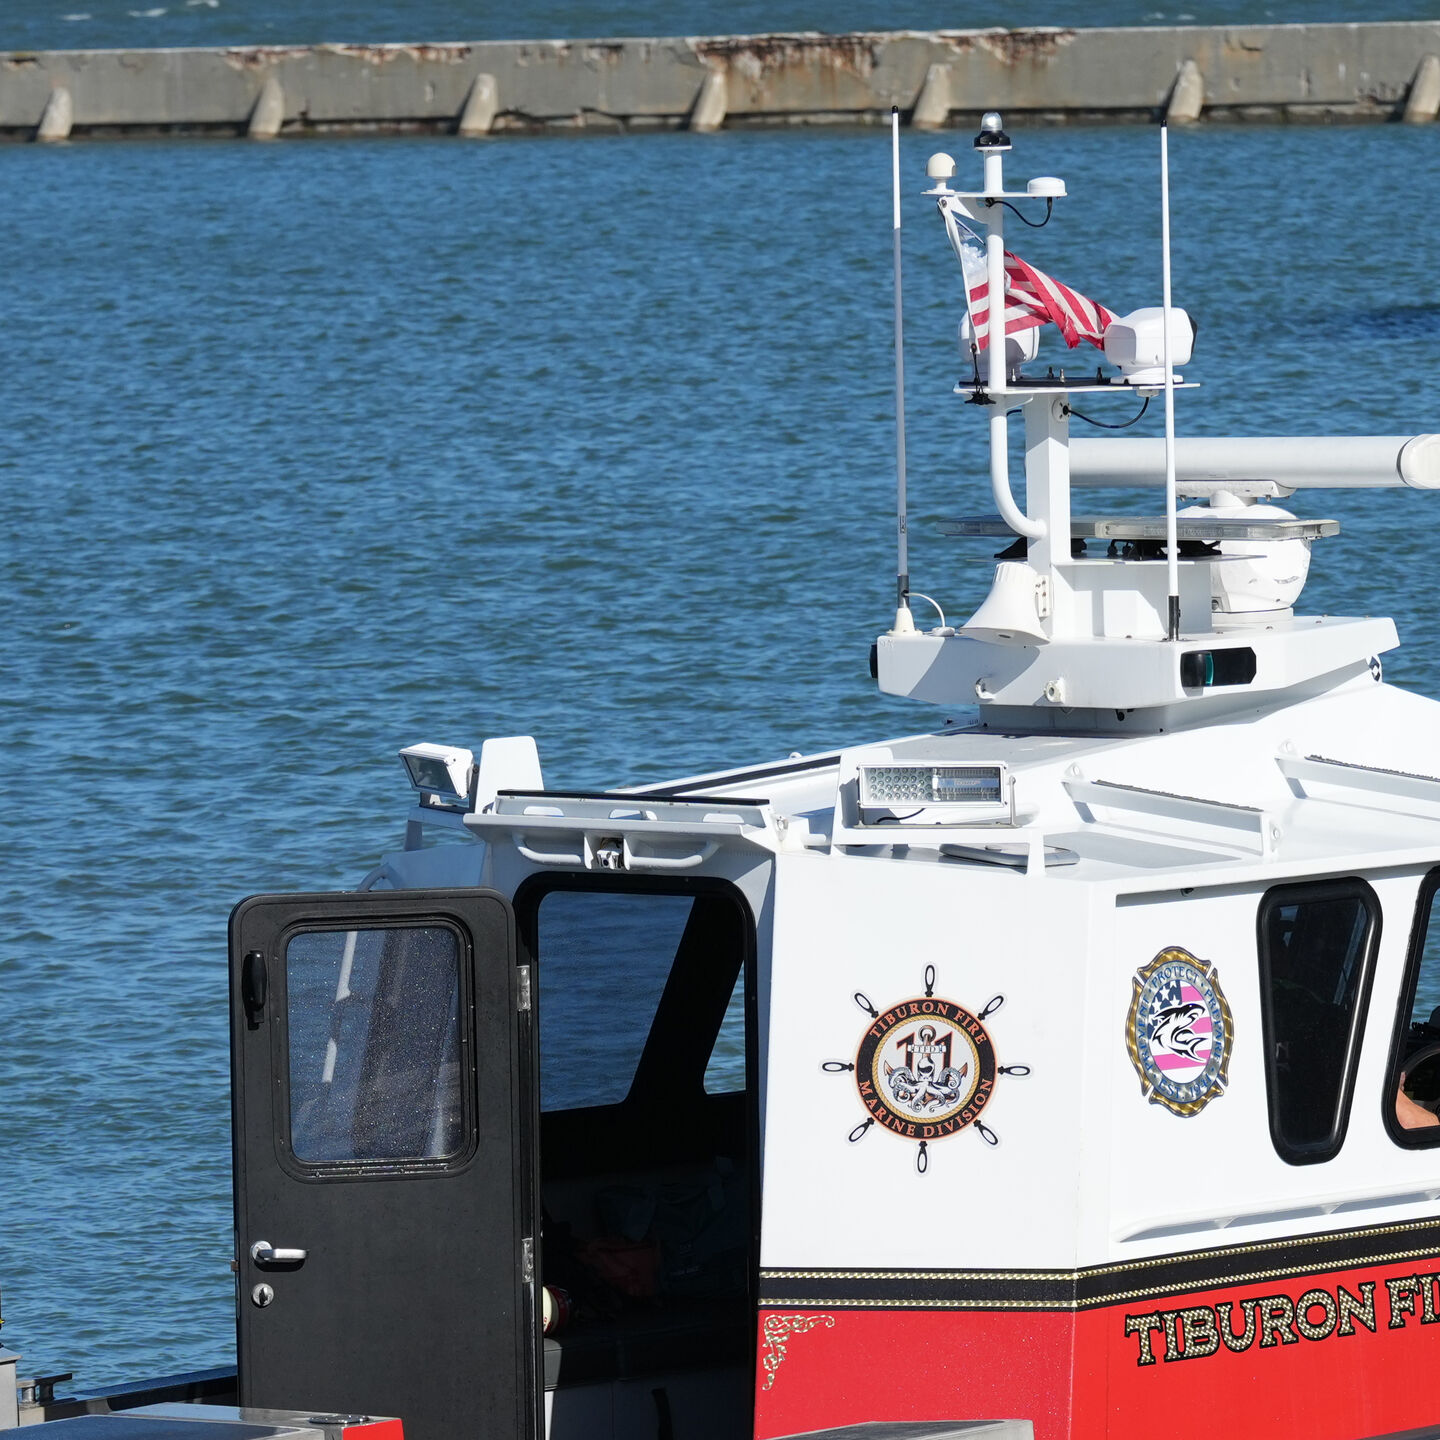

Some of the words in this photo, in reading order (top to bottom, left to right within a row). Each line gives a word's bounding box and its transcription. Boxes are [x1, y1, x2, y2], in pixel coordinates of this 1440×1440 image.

[1151, 965, 1199, 989] PROTECT
[870, 1002, 949, 1038] TIBURON
[954, 1011, 987, 1045] FIRE
[859, 1079, 916, 1137] MARINE
[923, 1078, 993, 1138] DIVISION
[1158, 1078, 1185, 1100] EST.
[1124, 1280, 1377, 1368] TIBURON
